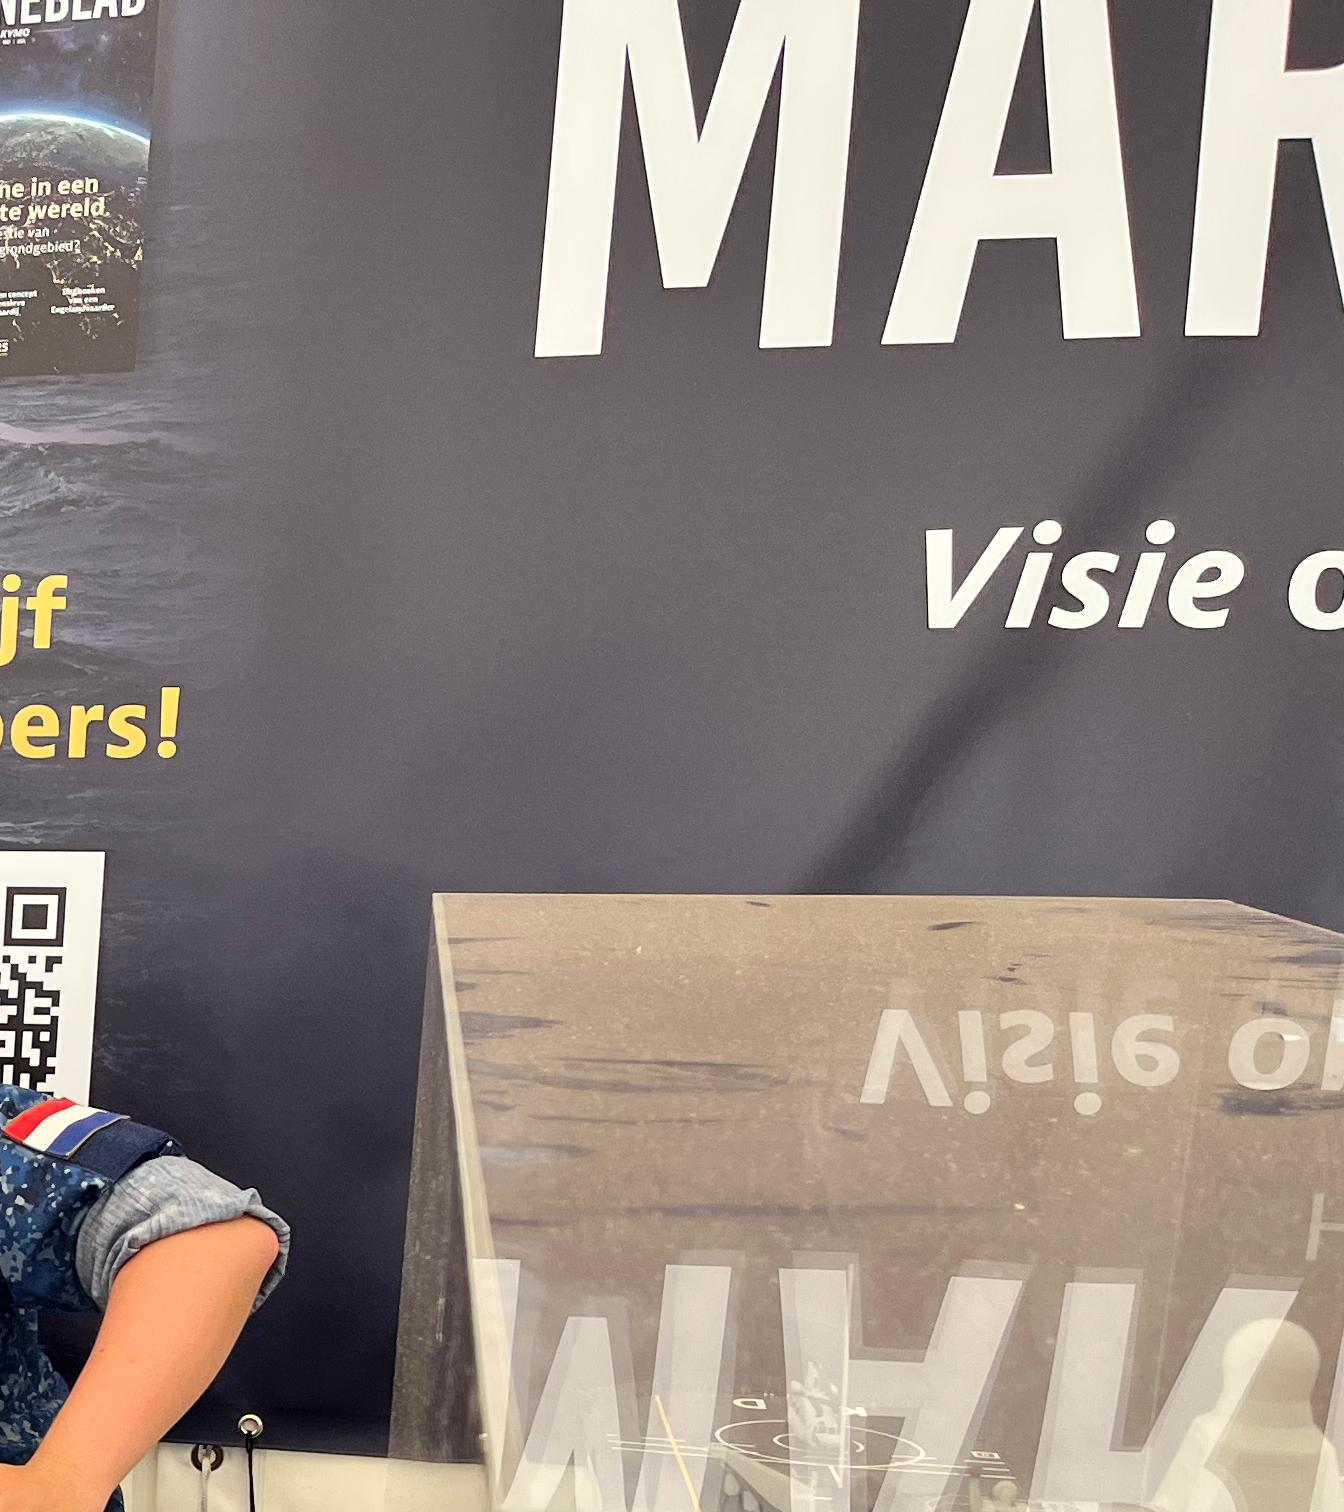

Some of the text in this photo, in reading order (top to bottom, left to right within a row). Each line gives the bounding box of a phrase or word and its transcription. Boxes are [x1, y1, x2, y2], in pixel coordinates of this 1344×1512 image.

[0, 28, 30, 38] KVMO
[31, 177, 51, 196] in
[57, 177, 99, 194] een
[534, 0, 1344, 357] MAR
[28, 197, 110, 220] wereld.
[28, 228, 49, 238] van
[925, 519, 1244, 630] Visie
